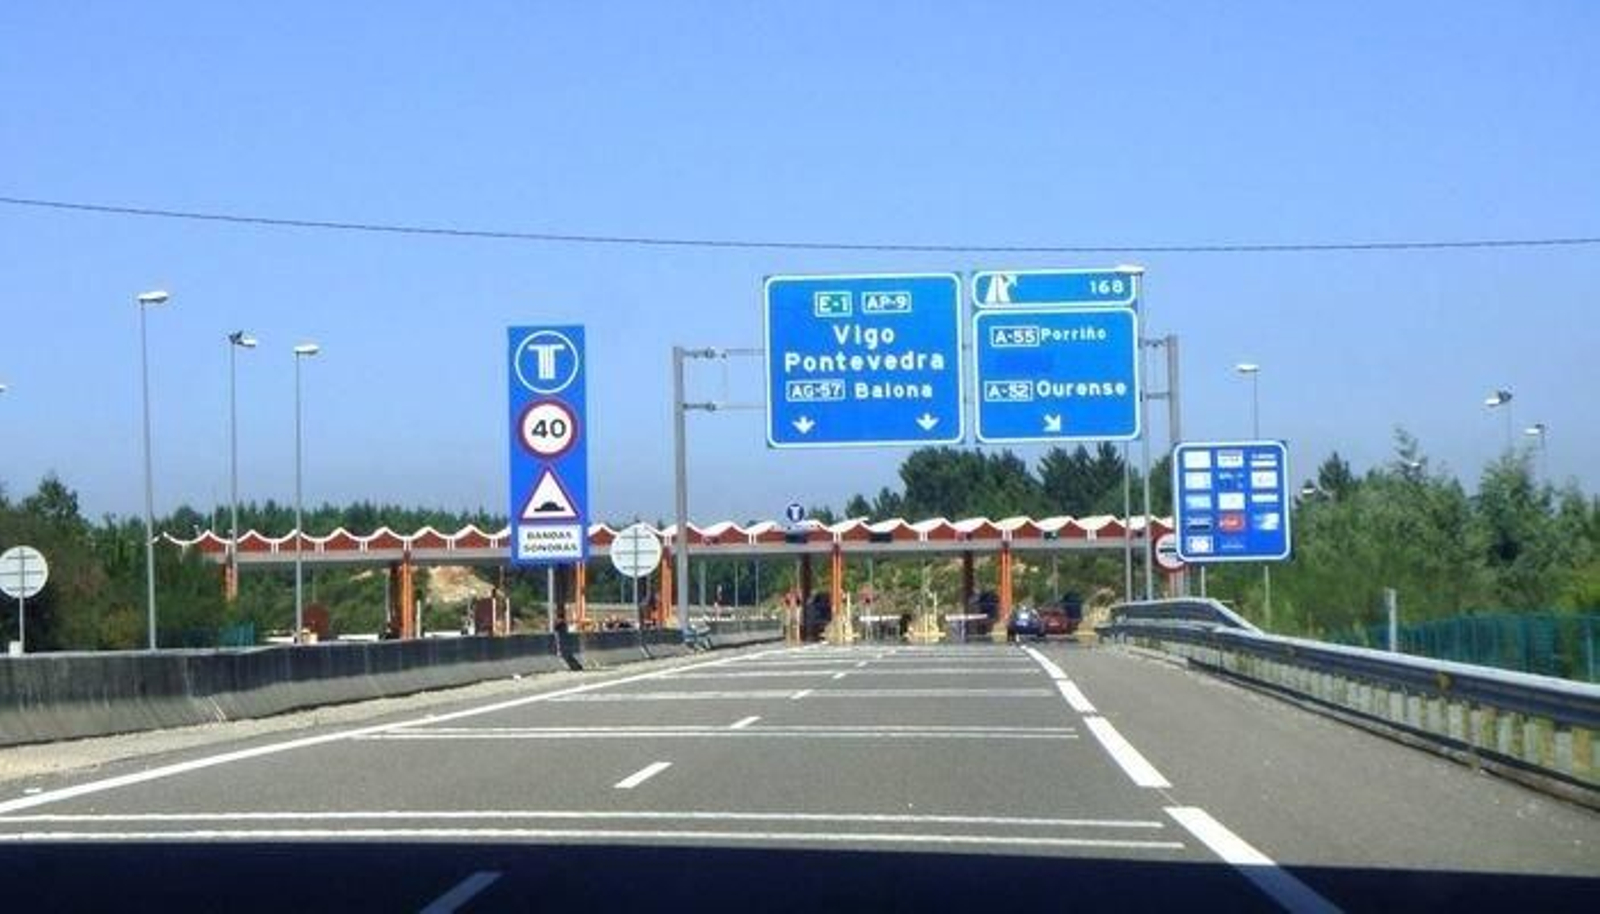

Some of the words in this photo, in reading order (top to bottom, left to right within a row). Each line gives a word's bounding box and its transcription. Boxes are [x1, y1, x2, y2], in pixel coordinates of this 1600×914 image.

[1088, 279, 1125, 295] 168
[818, 295, 849, 313] E-1
[866, 294, 907, 311] AP-9
[833, 323, 896, 350] Vigo
[994, 329, 1036, 344] A-55
[784, 350, 945, 373] Pontevedra
[791, 383, 842, 399] AG-57
[854, 381, 934, 399] Baiona
[988, 384, 1029, 399] A-52
[1036, 379, 1127, 398] Ourense
[531, 418, 567, 439] 40
